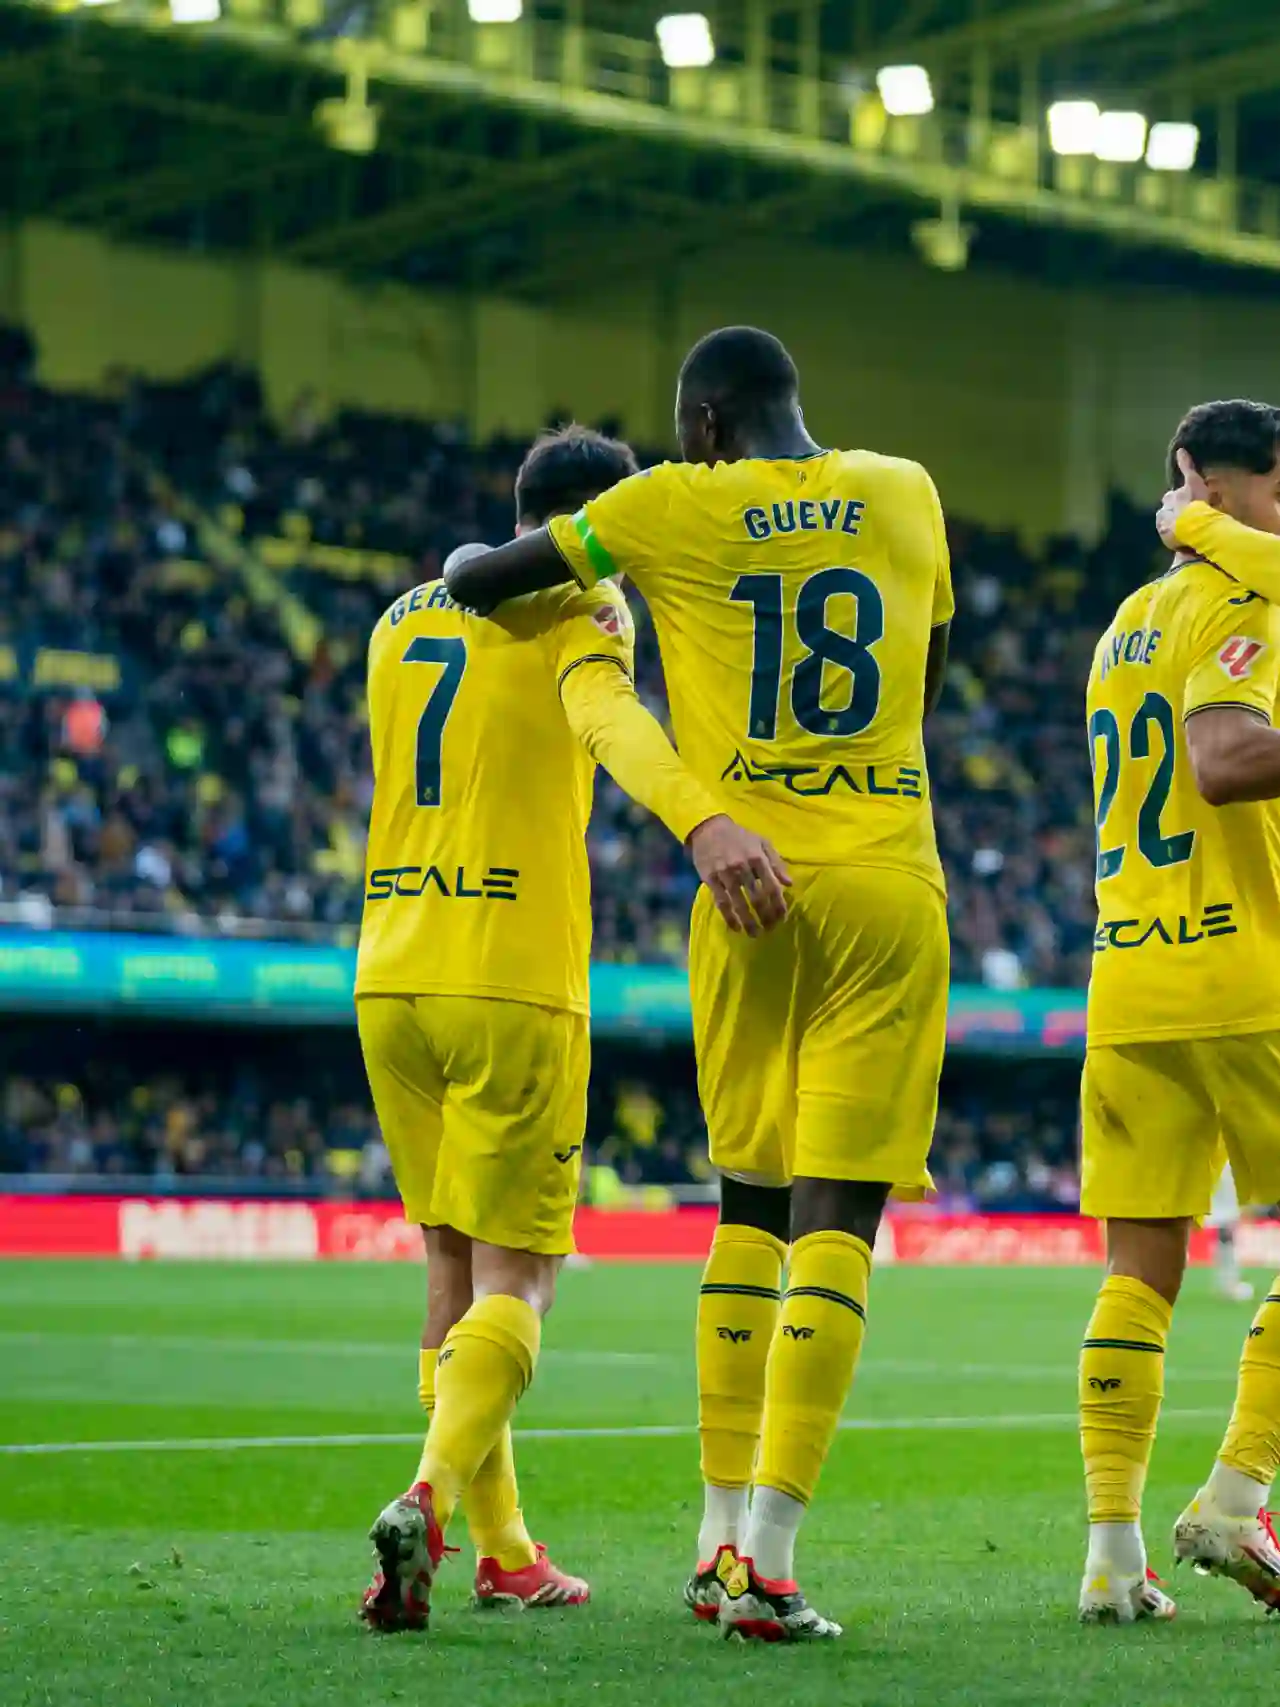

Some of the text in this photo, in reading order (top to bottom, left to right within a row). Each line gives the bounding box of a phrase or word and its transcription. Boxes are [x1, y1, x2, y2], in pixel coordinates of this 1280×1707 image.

[743, 499, 865, 540] GUEYE
[728, 567, 885, 741] 18
[400, 636, 467, 807] 7
[1089, 691, 1197, 881] 22
[366, 865, 520, 901] SCALE
[1094, 903, 1238, 951] SCALE
